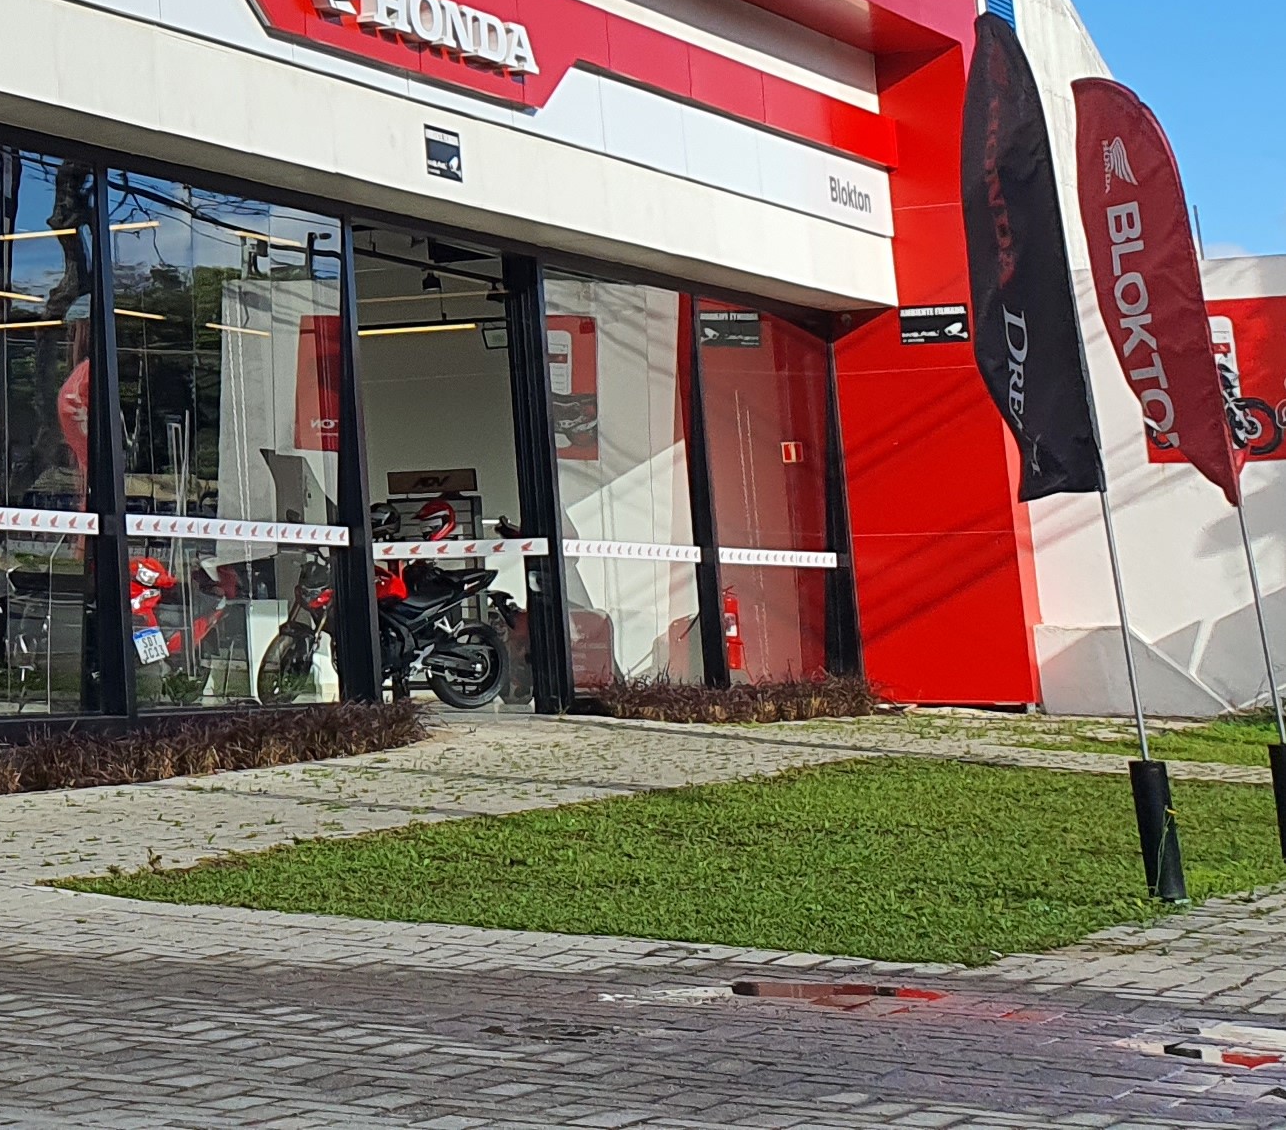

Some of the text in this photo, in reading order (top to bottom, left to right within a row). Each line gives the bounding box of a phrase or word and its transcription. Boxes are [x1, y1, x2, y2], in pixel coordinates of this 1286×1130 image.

[829, 175, 872, 214] Blokton
[1101, 139, 1111, 195] HONDA
[1106, 201, 1180, 448] BLOKTO
